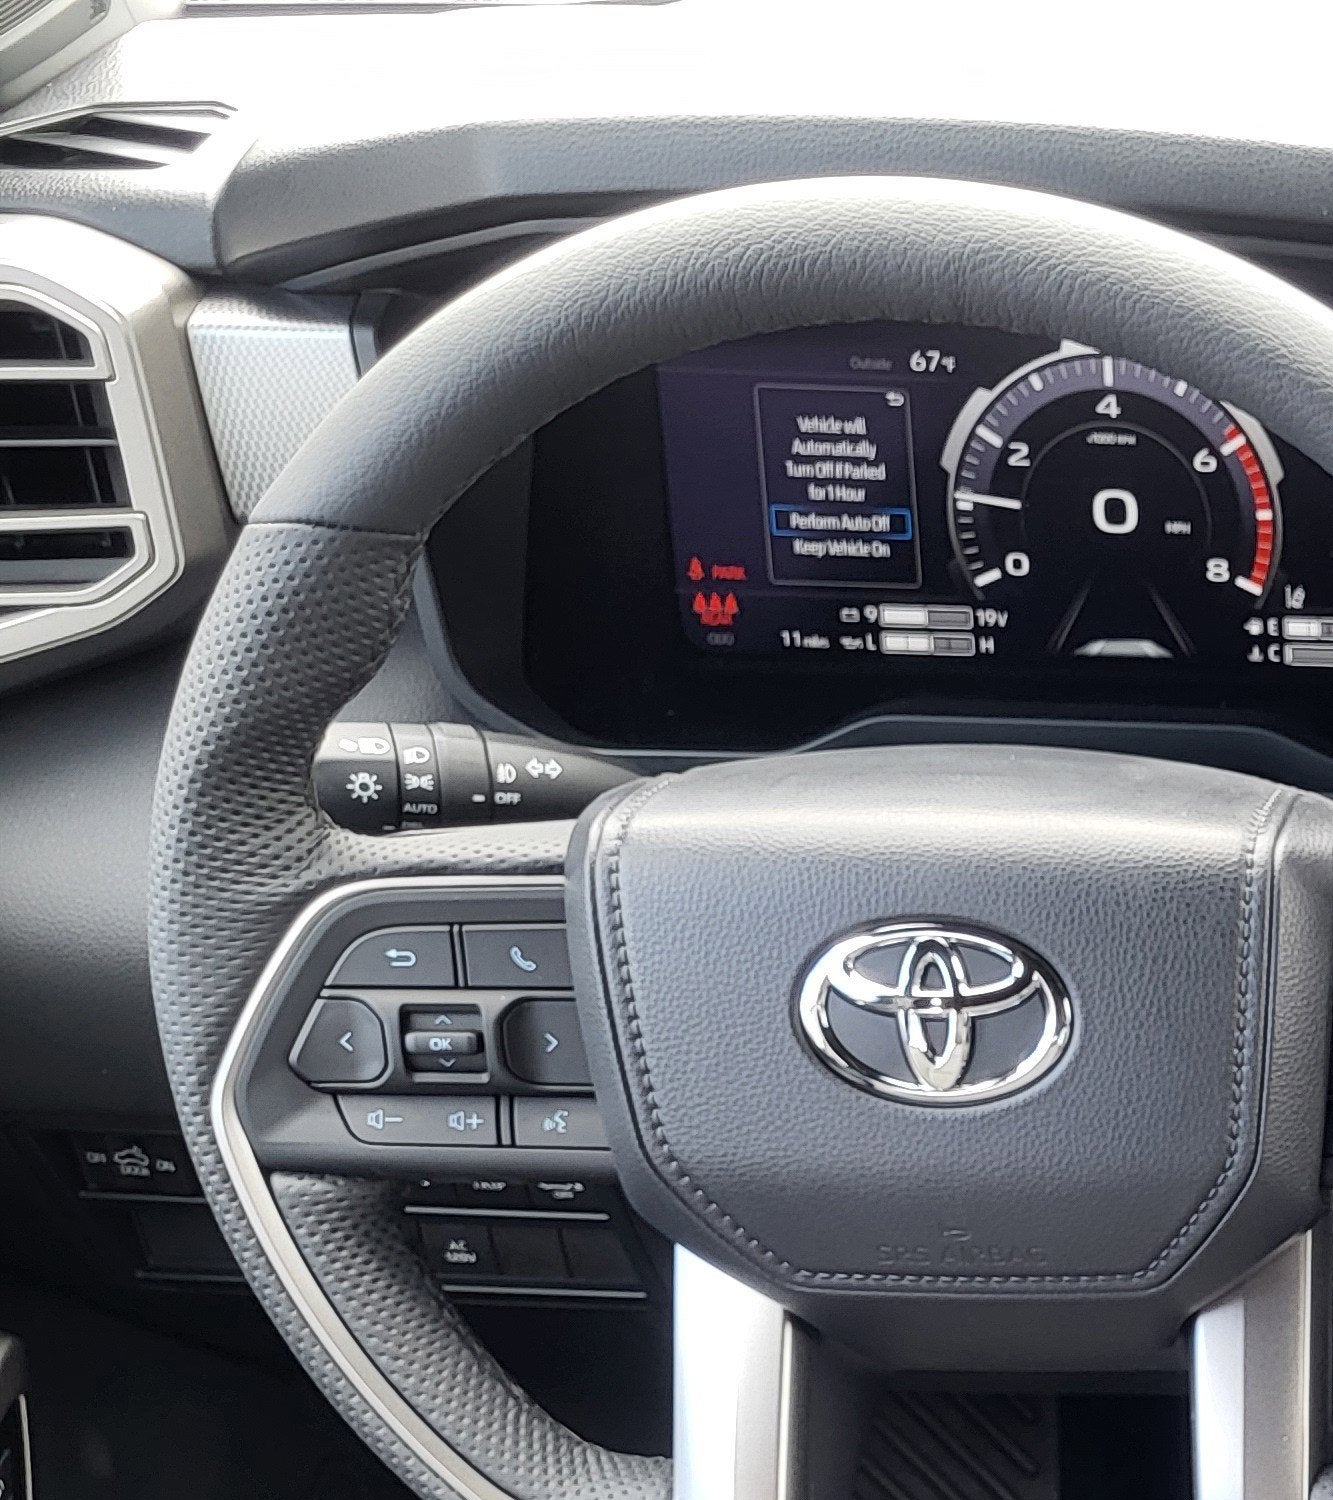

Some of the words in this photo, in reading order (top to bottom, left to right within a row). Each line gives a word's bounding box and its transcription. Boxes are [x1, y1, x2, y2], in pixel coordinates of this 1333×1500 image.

[1095, 394, 1122, 419] 4
[796, 414, 843, 435] Vehicle
[843, 415, 867, 435] will
[791, 437, 877, 461] Automatically
[1007, 441, 1032, 467] 2
[785, 459, 815, 478] Turn
[815, 460, 834, 479] Off
[844, 461, 887, 481] Parked
[1192, 447, 1218, 474] 6
[807, 482, 826, 501] for
[827, 483, 835, 501] 1
[835, 484, 866, 502] Hour
[789, 511, 841, 532] Perform
[841, 513, 871, 533] Auto
[871, 513, 891, 533] Off
[1092, 488, 1139, 535] 0
[792, 537, 826, 558] Keep
[827, 538, 870, 558] Vehicle
[871, 539, 891, 559] On
[1004, 551, 1031, 578] 0
[1205, 557, 1231, 584] 8
[863, 604, 879, 623] 9
[975, 608, 1009, 628] 19V
[1266, 617, 1280, 636] E
[780, 630, 801, 648] 11
[865, 632, 878, 651] L
[979, 636, 995, 654] H
[1267, 643, 1281, 662] C
[402, 802, 438, 815] AUTO
[494, 791, 522, 806] OFF
[428, 1036, 453, 1052] OK
